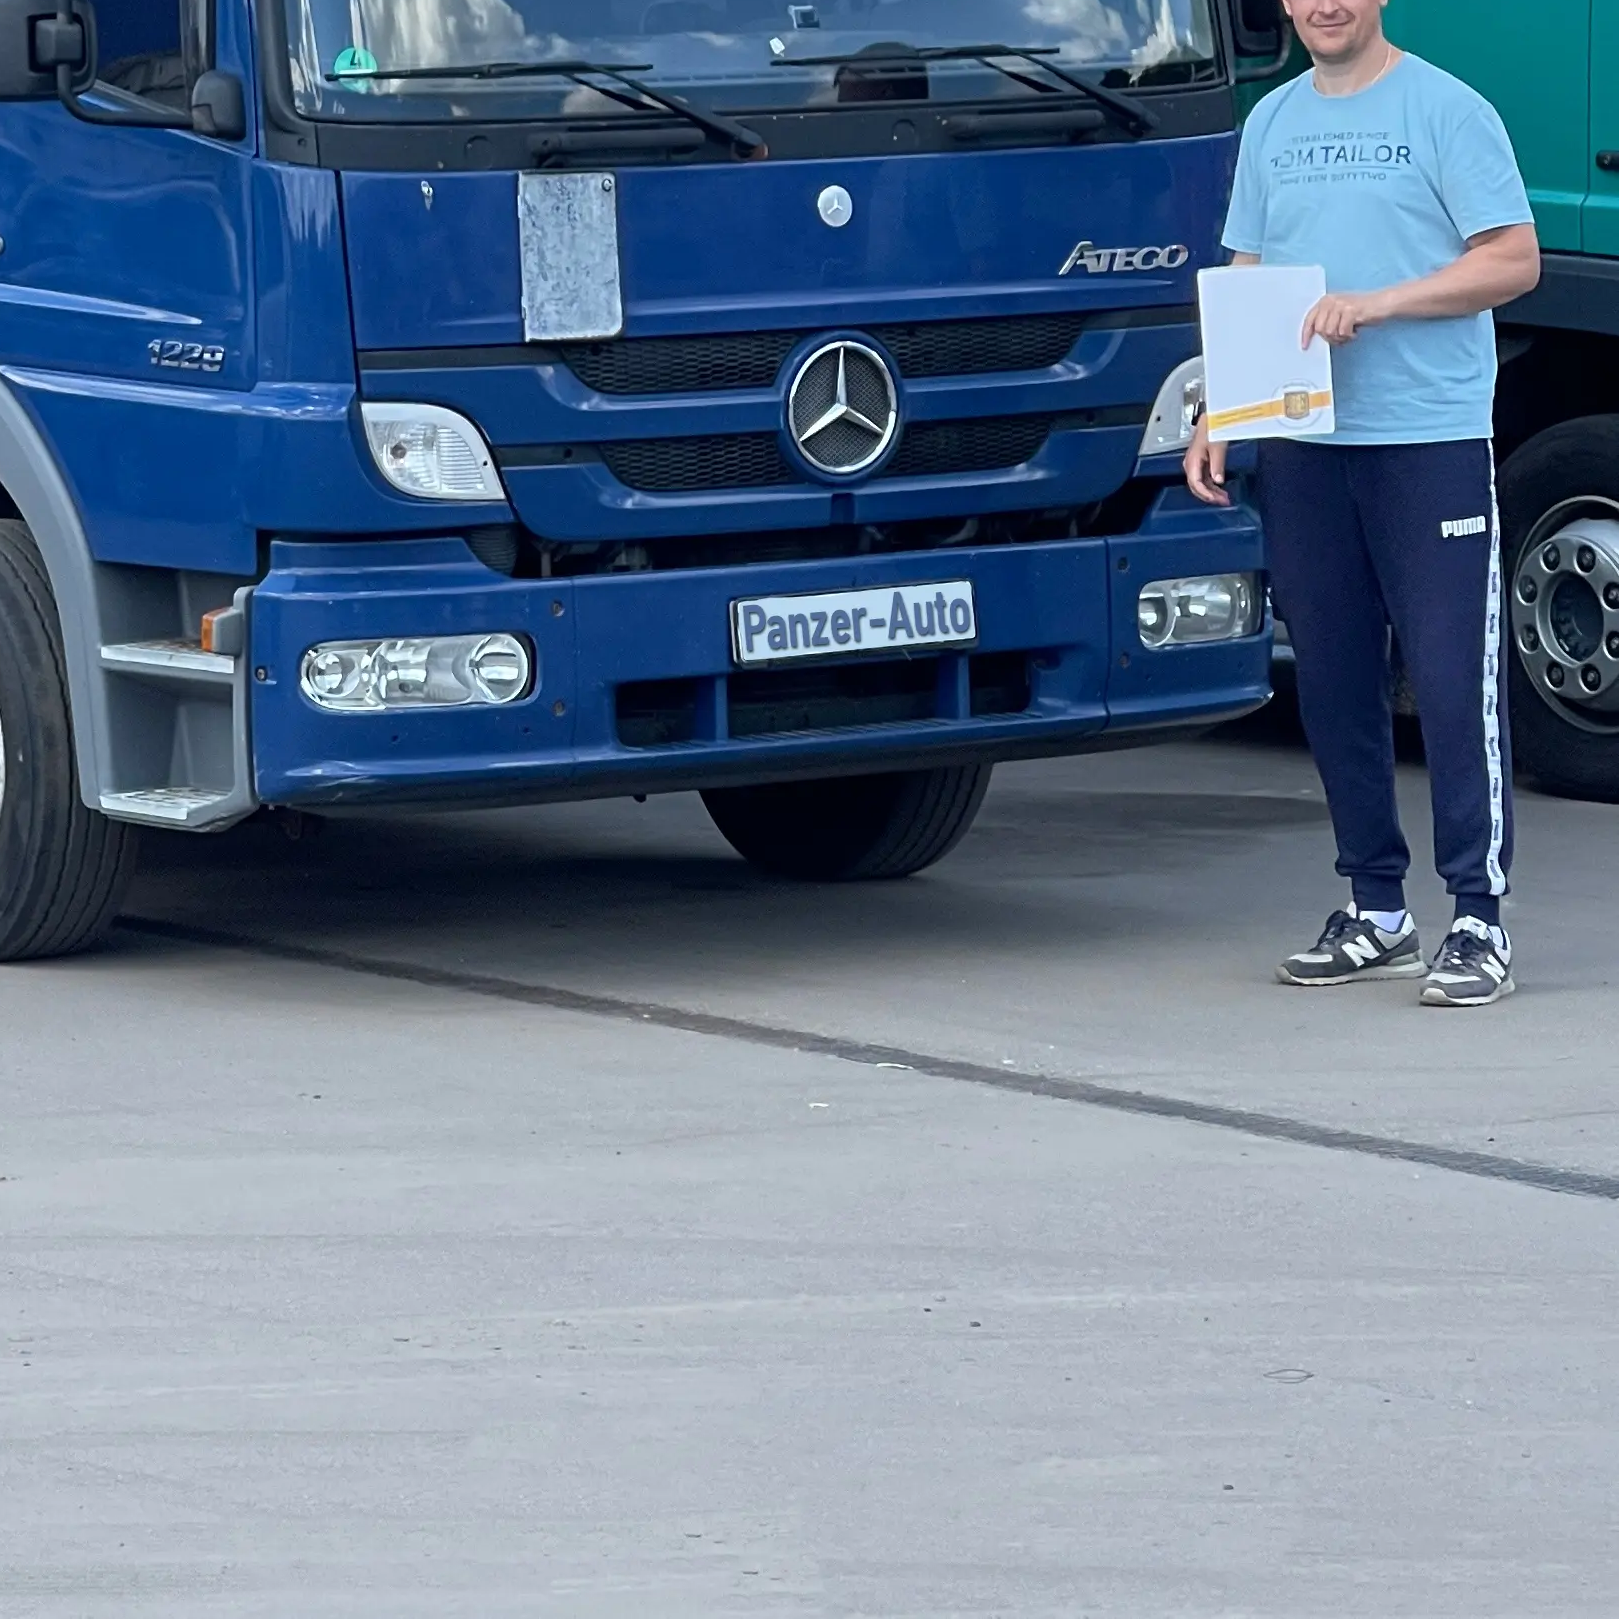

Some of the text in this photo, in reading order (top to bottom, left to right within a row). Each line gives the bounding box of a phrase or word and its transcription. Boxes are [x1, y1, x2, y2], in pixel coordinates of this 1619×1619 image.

[1320, 144, 1412, 165] TAILOR
[1058, 240, 1189, 276] ATEGO
[1441, 515, 1486, 538] PUMA
[742, 590, 972, 653] Panzer-Auto
